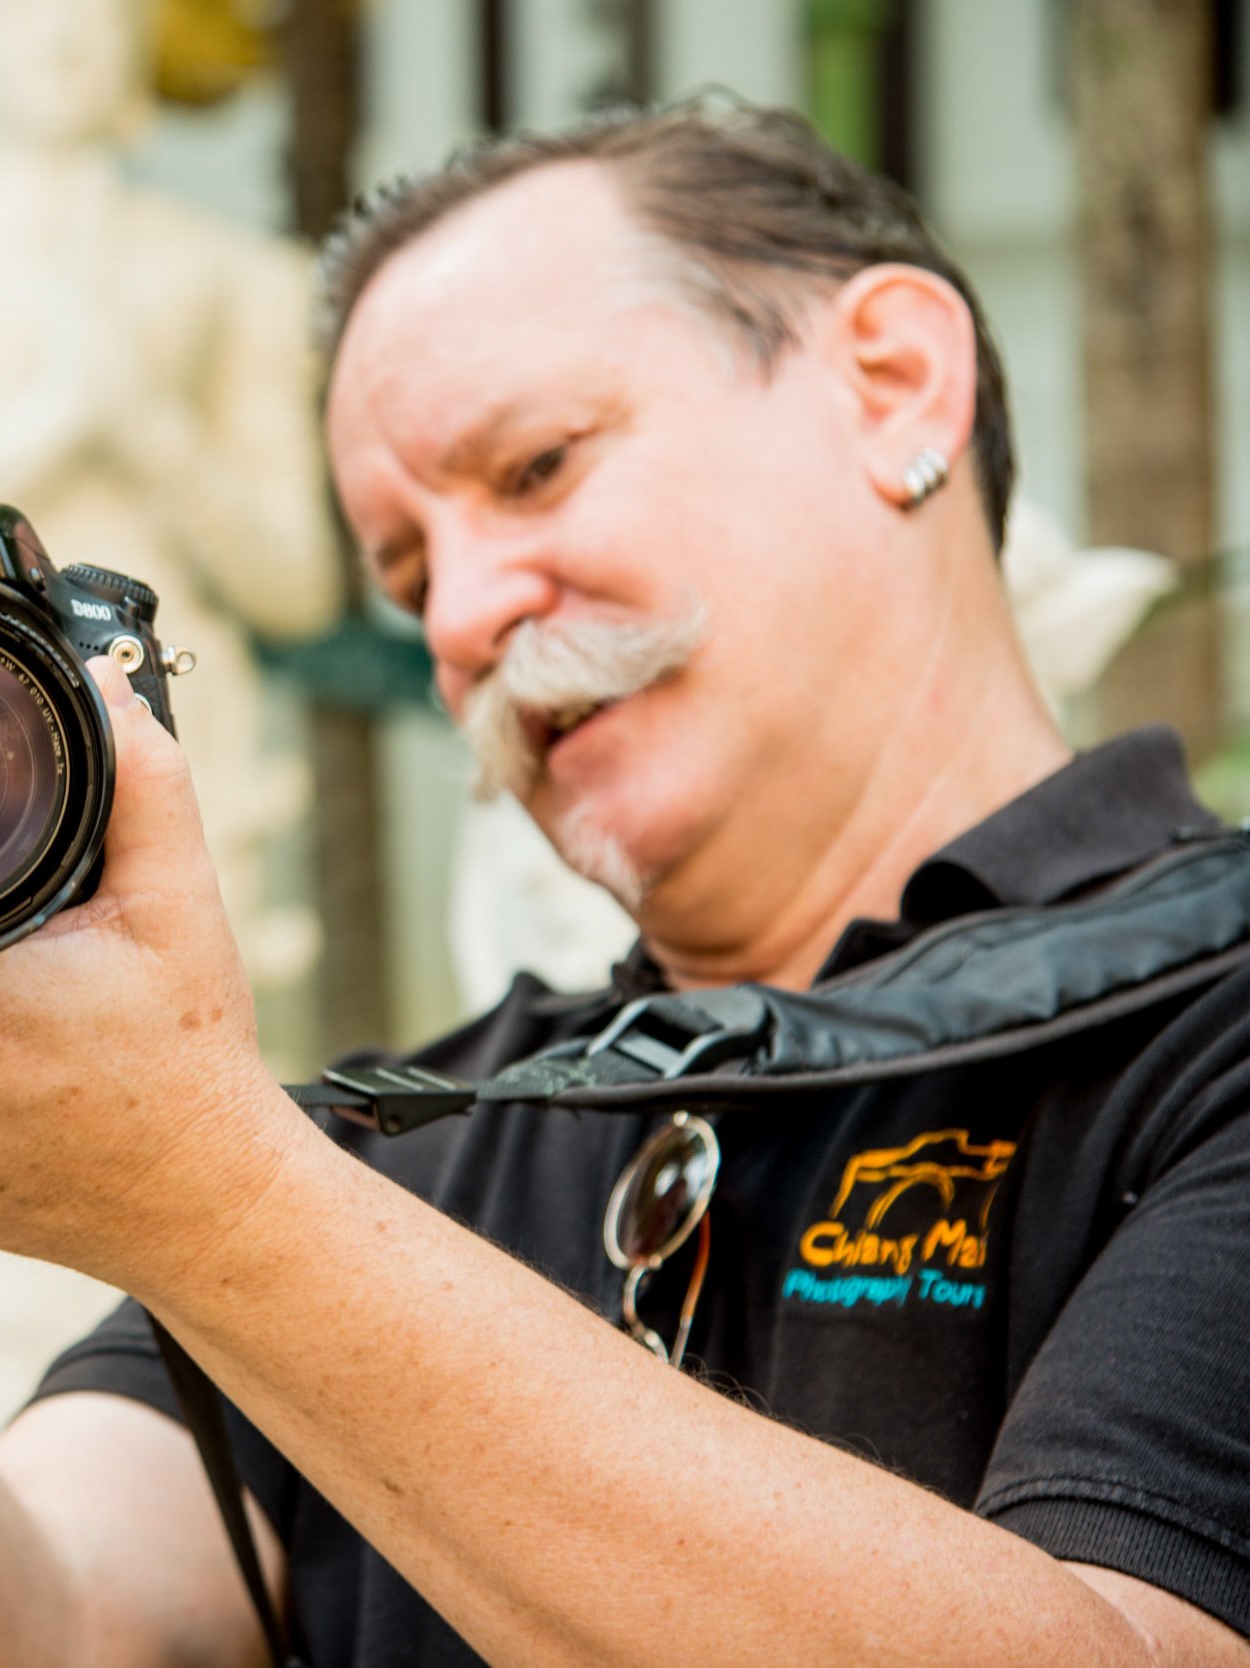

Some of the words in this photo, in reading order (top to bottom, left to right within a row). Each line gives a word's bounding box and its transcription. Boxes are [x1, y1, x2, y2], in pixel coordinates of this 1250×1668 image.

[71, 599, 112, 621] D800
[800, 1221, 918, 1275] Chiang
[918, 1268, 986, 1308] Tours
